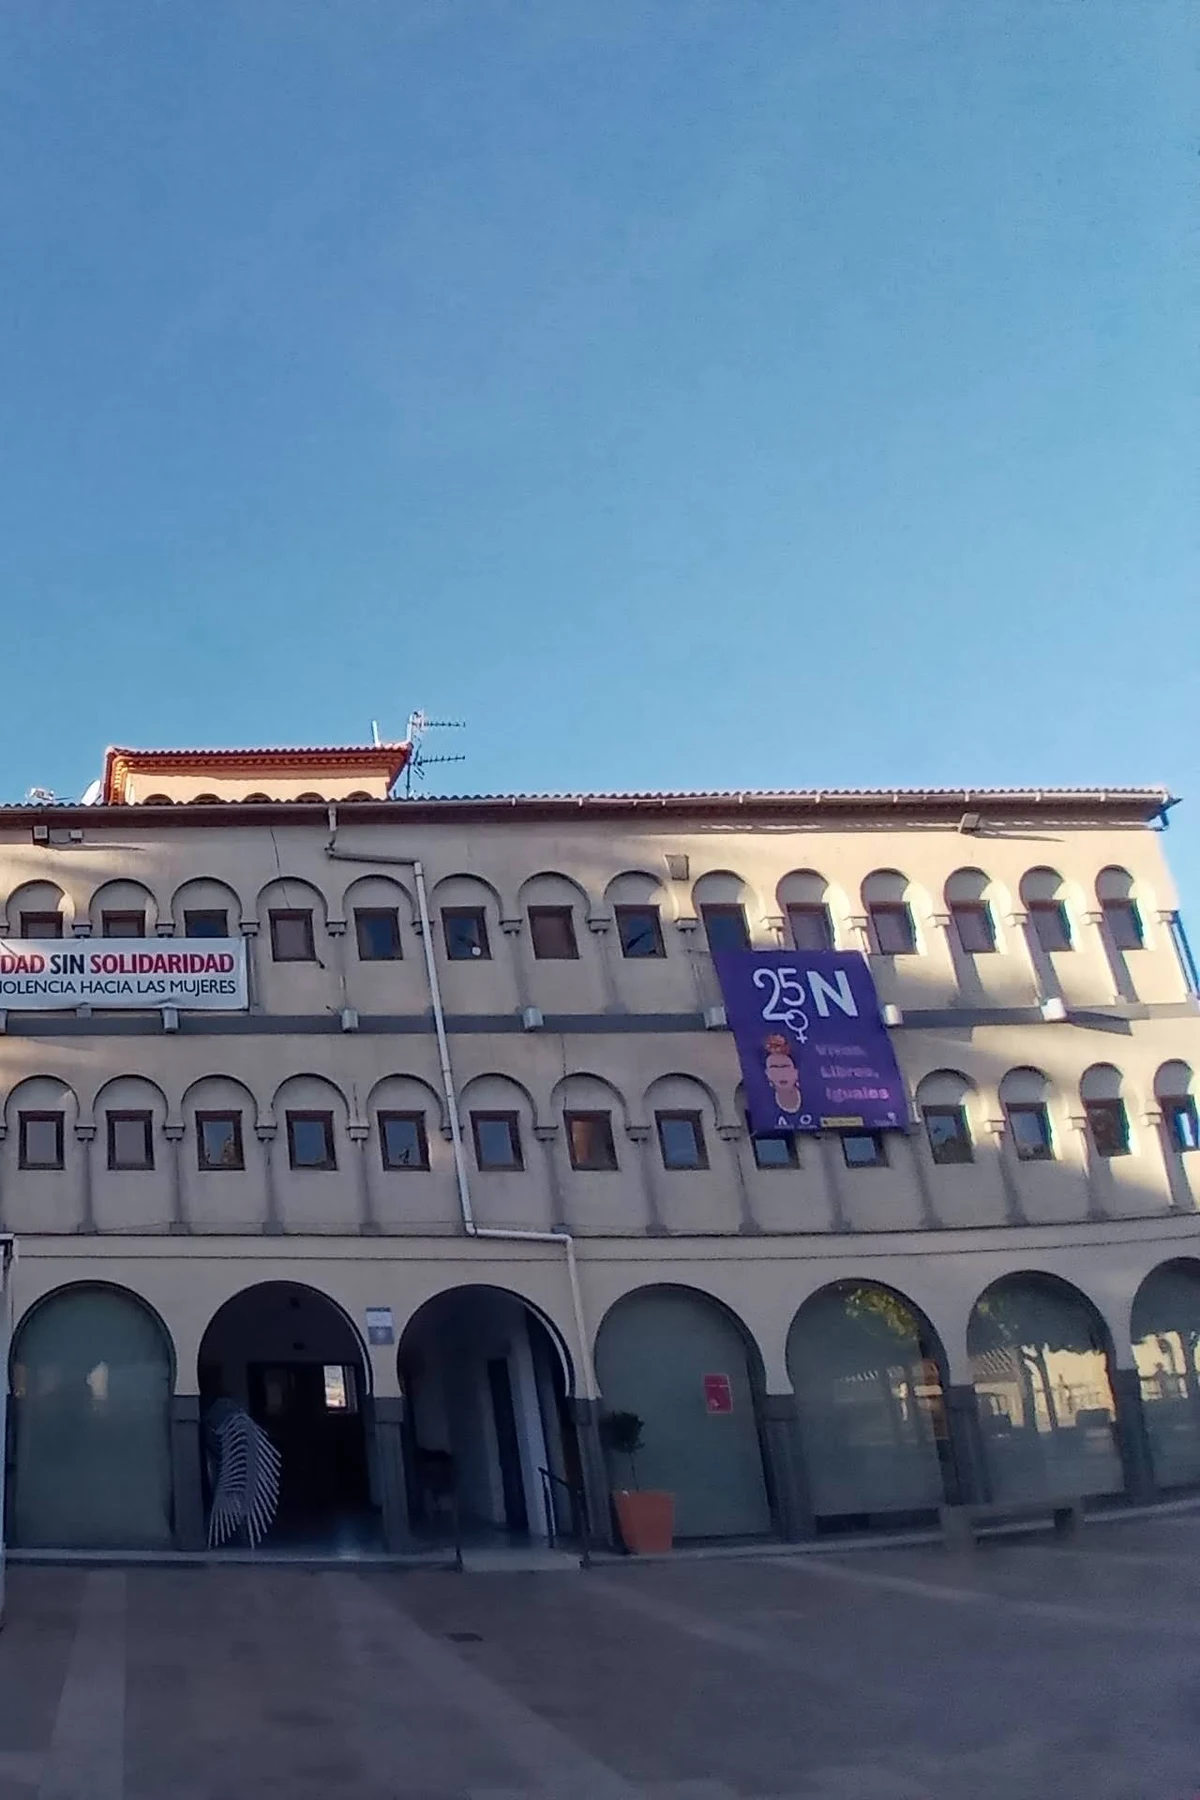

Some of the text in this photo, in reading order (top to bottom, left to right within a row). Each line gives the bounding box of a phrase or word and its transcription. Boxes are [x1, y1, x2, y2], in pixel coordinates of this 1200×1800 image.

[50, 954, 85, 975] SIN
[90, 953, 235, 974] SOLIDARIDAD
[80, 980, 134, 994] HACIA
[137, 980, 166, 993] LAS
[170, 979, 237, 997] MUJERES
[826, 1087, 890, 1103] Iguales
